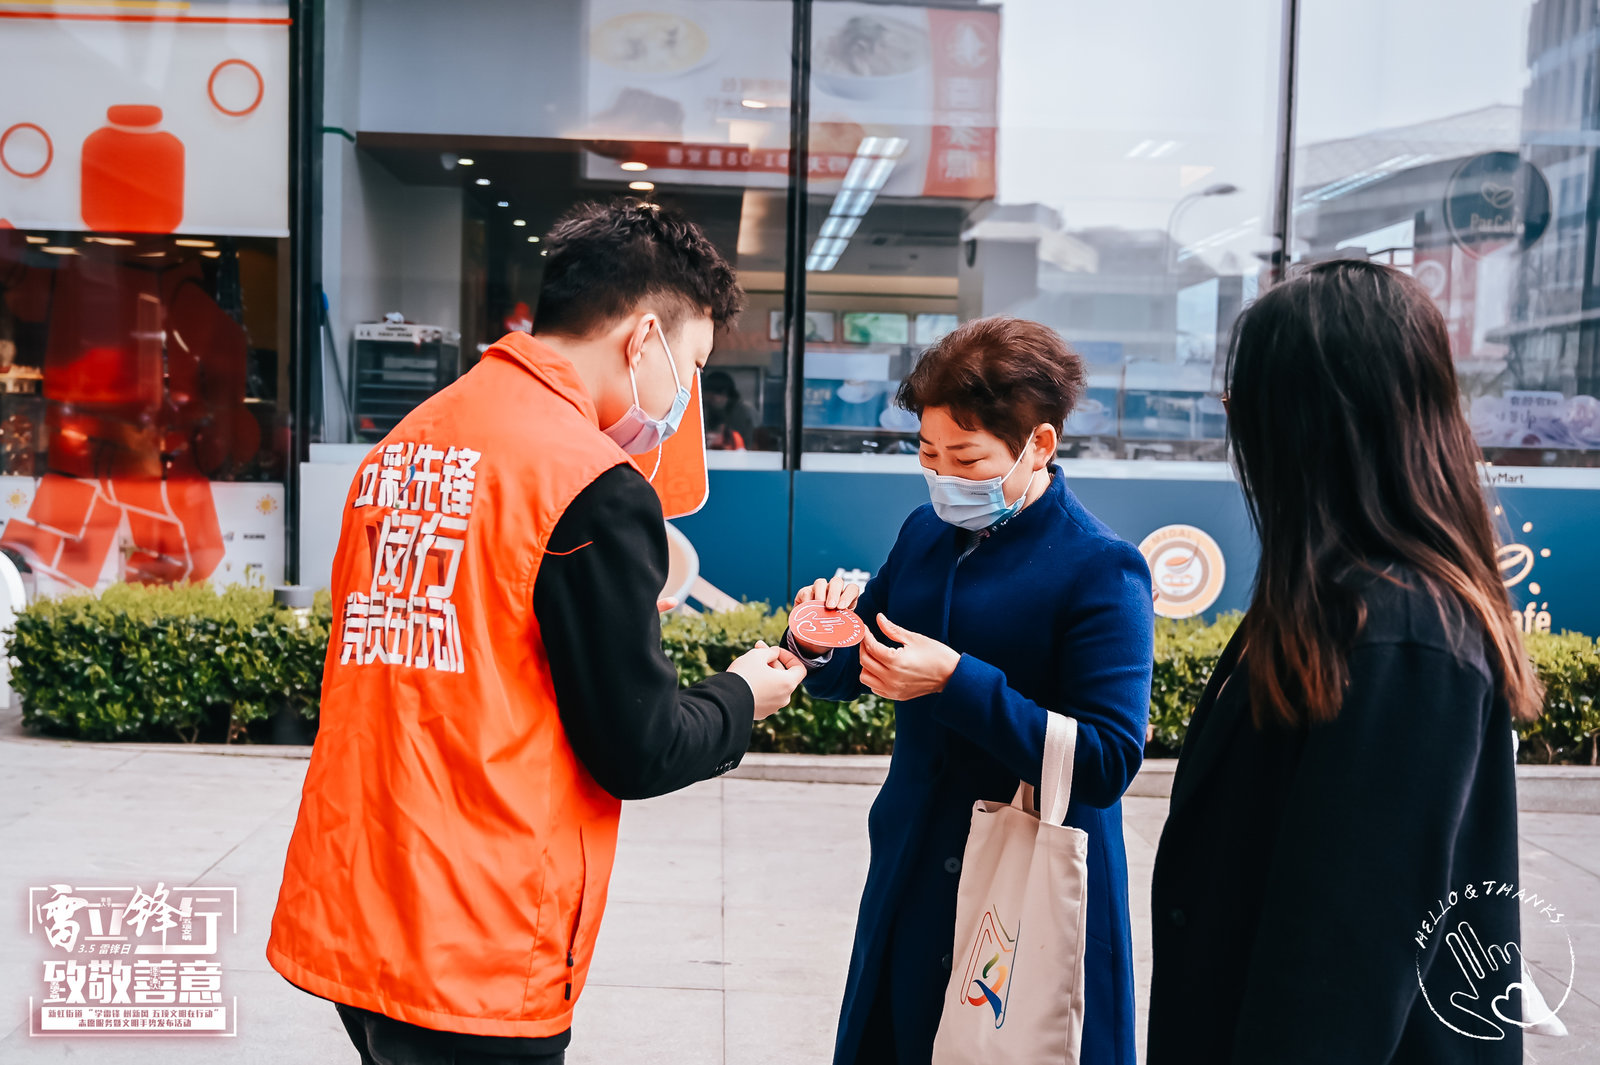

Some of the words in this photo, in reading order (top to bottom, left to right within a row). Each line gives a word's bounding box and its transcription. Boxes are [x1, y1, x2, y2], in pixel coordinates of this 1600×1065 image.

[370, 510, 469, 599] 闵行
[341, 592, 465, 674] 党员在行动
[1511, 601, 1552, 634] afé
